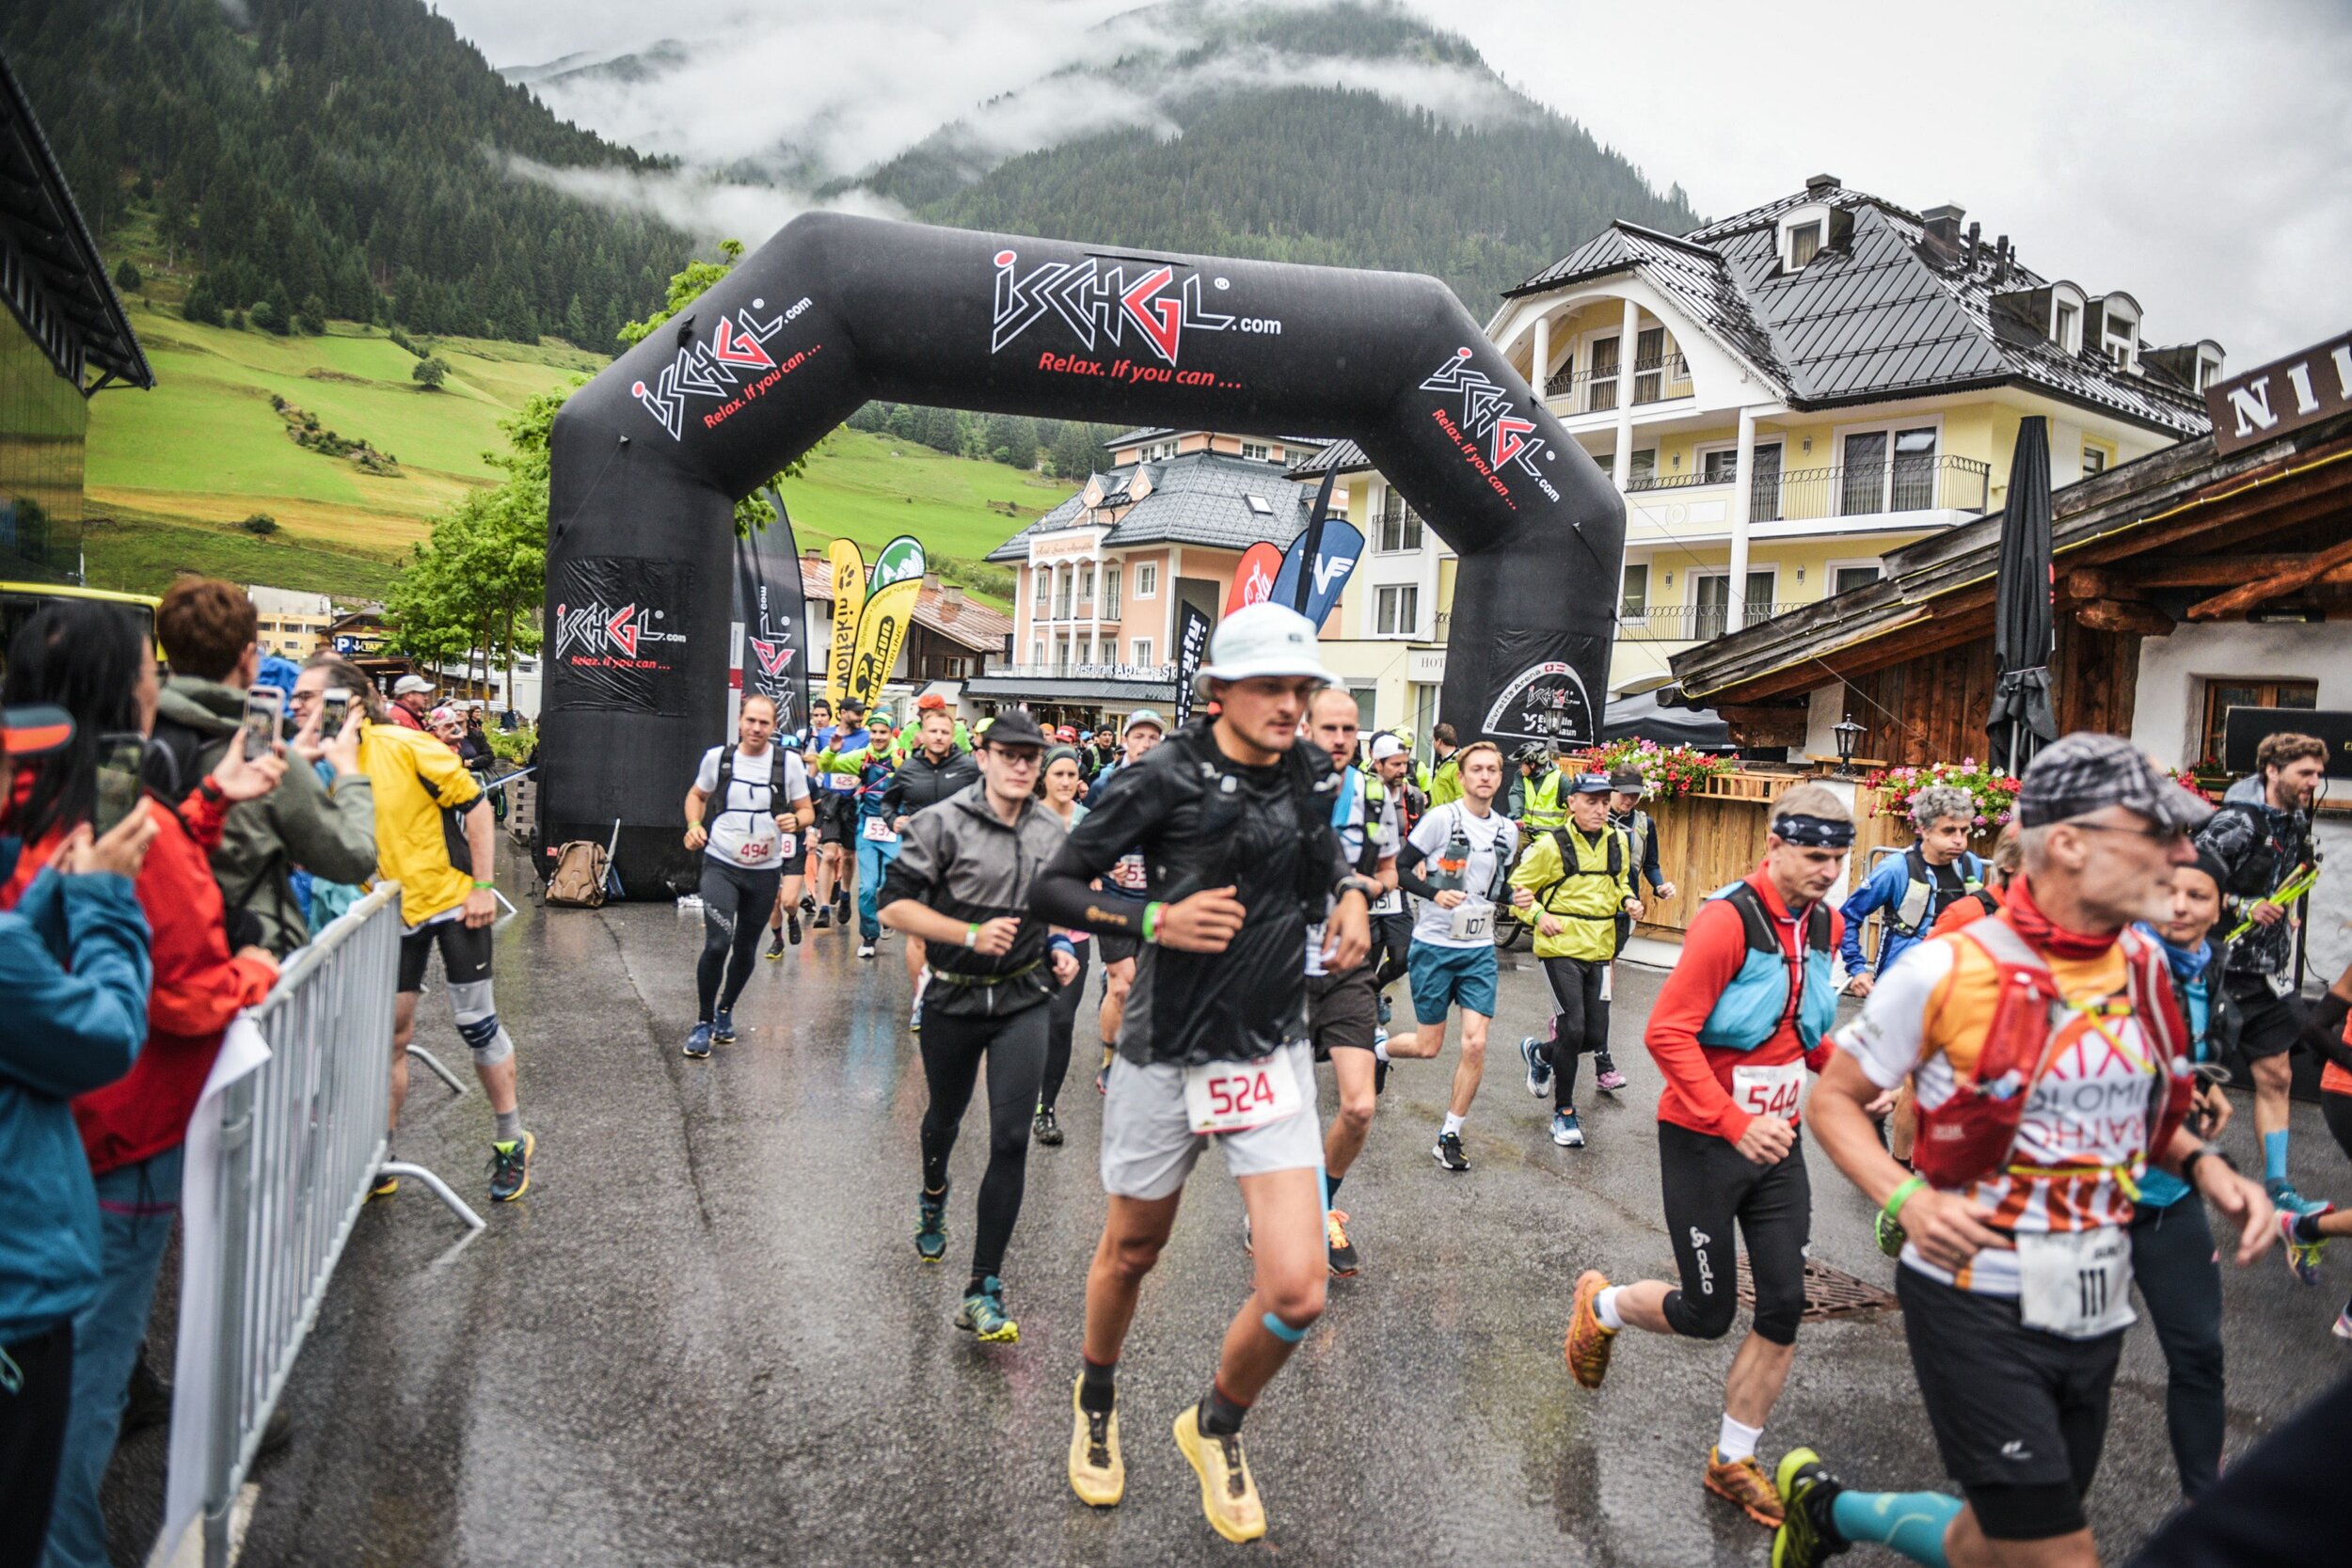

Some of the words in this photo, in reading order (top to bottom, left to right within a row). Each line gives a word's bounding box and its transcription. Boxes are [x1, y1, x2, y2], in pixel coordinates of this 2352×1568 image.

[1039, 352, 1104, 376] Relax.
[1111, 359, 1130, 378] If
[1130, 364, 1171, 385] you
[1177, 370, 1215, 387] can
[704, 399, 746, 429] Relax.
[744, 384, 758, 401] If
[755, 370, 782, 395] you
[782, 352, 805, 373] can
[1432, 408, 1462, 445] Relax.
[1461, 442, 1478, 459] If
[1467, 452, 1489, 478] you
[1488, 473, 1509, 497] can
[337, 638, 350, 652] P
[571, 656, 600, 666] Relax.
[612, 659, 633, 670] you
[636, 659, 657, 669] can
[1486, 691, 1515, 730] Silvretta
[1515, 669, 1541, 690] Arena
[870, 823, 890, 836] 53
[740, 843, 769, 858] 494
[1466, 918, 1486, 934] 107
[1209, 1071, 1274, 1115] 524
[1748, 1079, 1800, 1117] 544
[1696, 1249, 1714, 1295] odlo
[2079, 1268, 2106, 1318] 111
